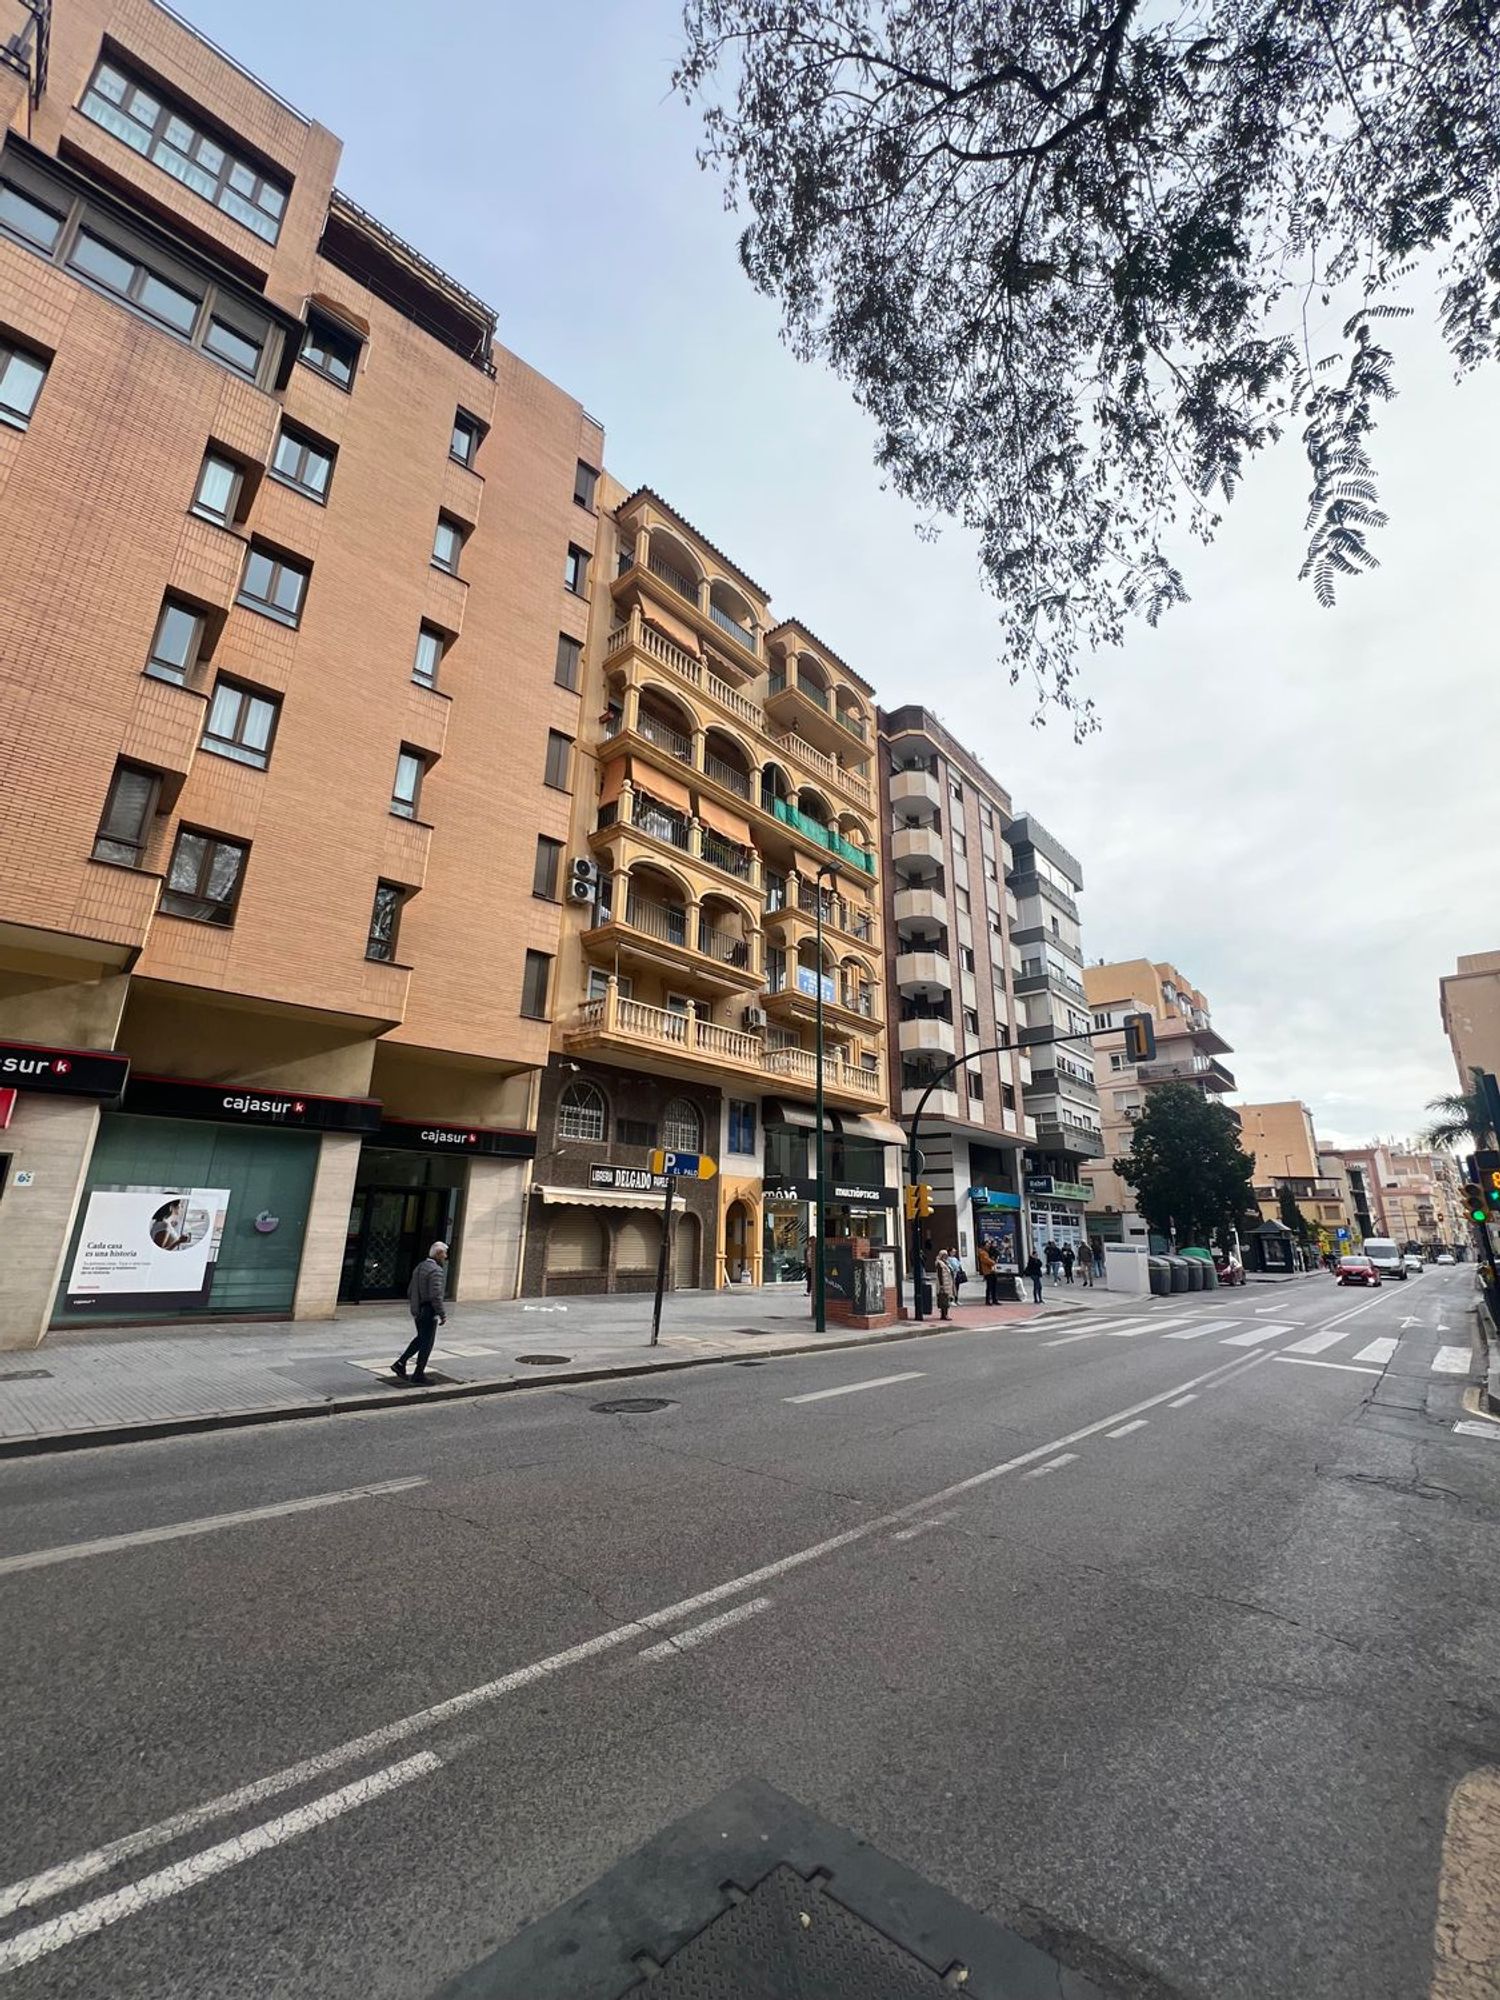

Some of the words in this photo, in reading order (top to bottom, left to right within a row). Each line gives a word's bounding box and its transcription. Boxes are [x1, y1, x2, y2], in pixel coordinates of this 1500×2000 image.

[0, 1058, 49, 1074] sur
[222, 1095, 291, 1114] cajasur
[421, 1129, 467, 1144] cajasur
[664, 1153, 676, 1173] P
[615, 1169, 652, 1190] DELGADO
